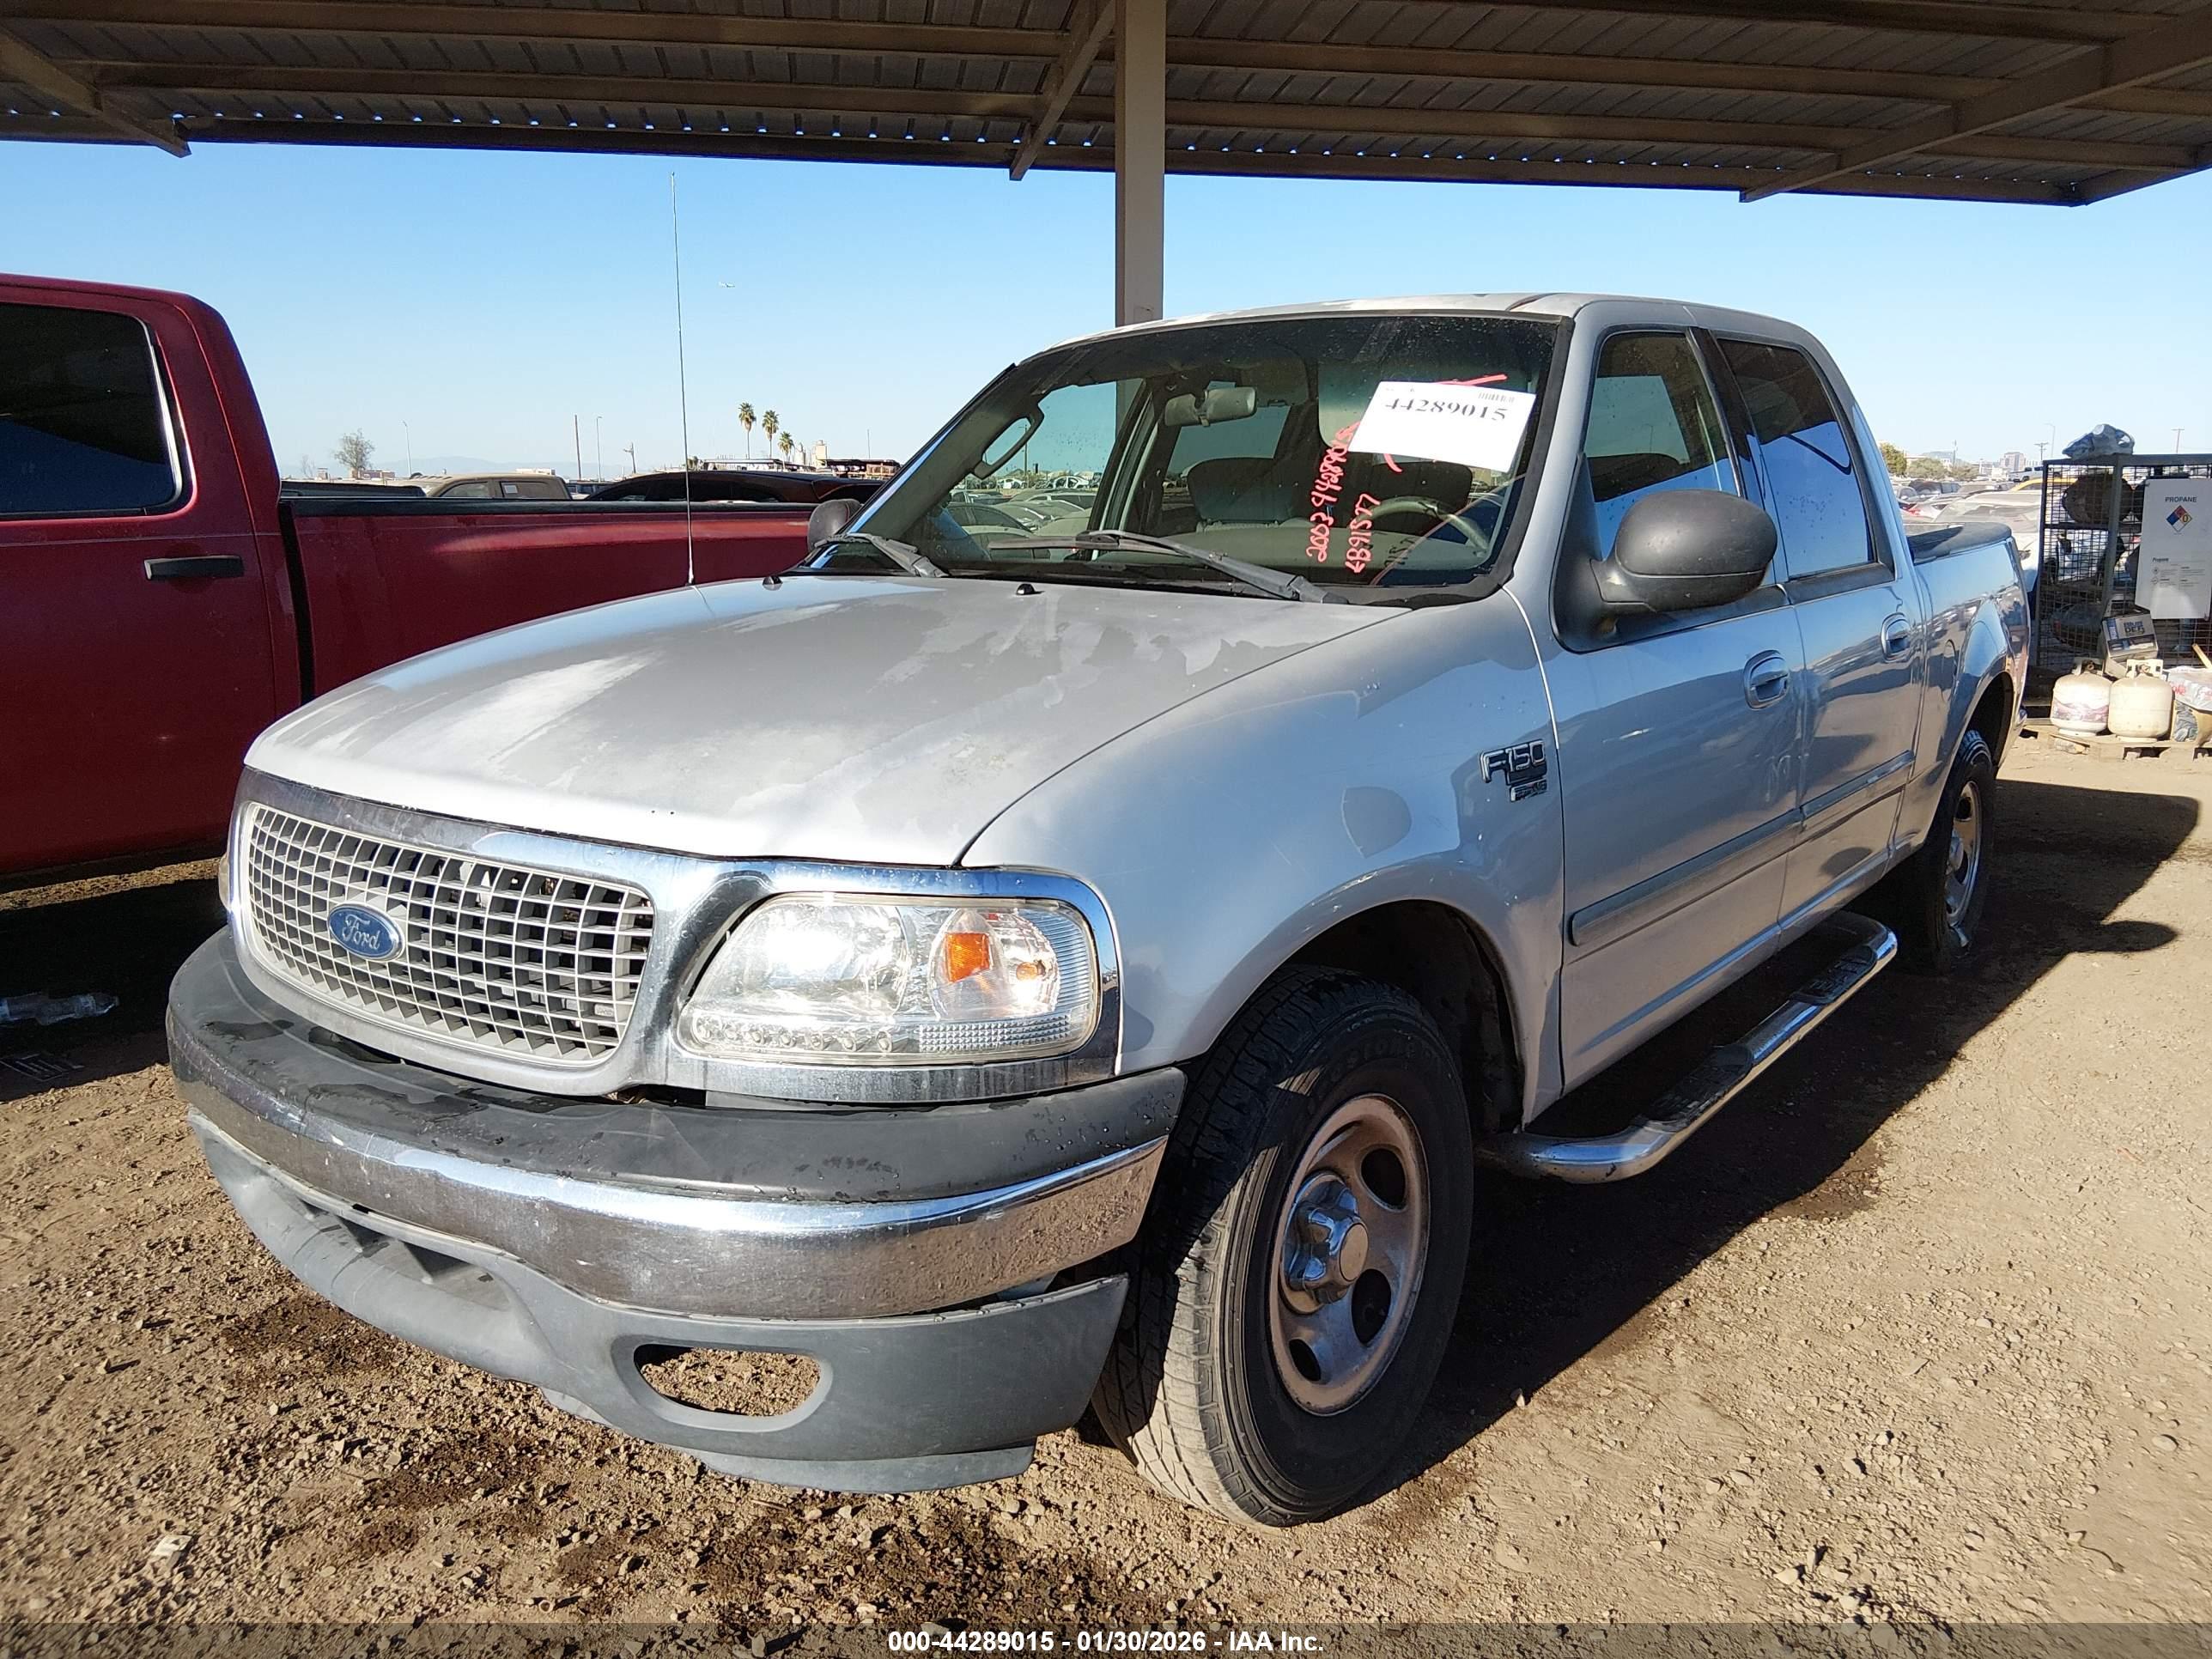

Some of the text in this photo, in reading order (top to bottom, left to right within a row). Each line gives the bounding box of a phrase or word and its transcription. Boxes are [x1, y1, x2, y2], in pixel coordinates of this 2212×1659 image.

[1384, 398, 1509, 421] 44289015
[1306, 512, 1334, 562] 2003
[341, 914, 380, 951] Ford
